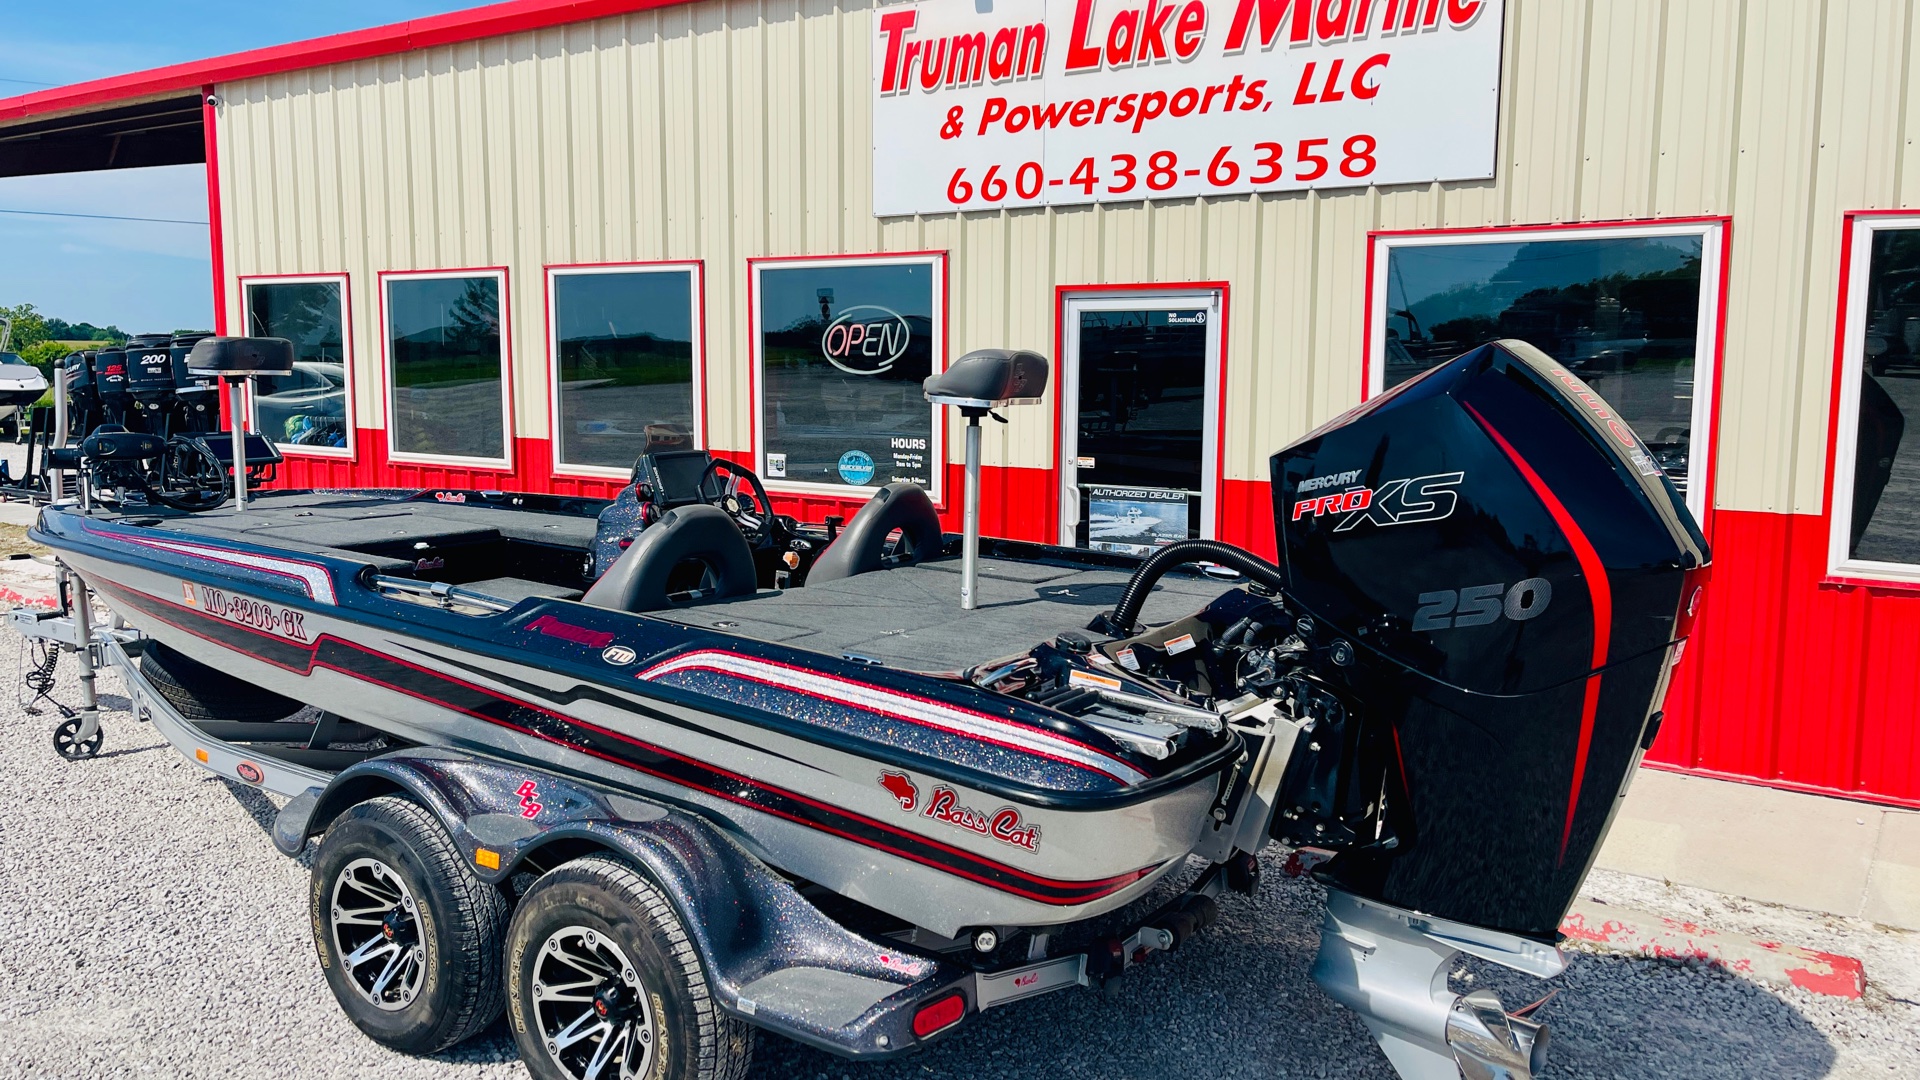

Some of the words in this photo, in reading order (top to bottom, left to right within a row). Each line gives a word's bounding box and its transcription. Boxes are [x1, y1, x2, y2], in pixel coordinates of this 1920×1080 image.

[880, 10, 1048, 94] Truman
[1064, 0, 1207, 72] Lake
[940, 105, 964, 140] &
[977, 80, 1273, 137] Powersports,
[1292, 53, 1392, 106] LLC
[947, 134, 1377, 204] 660-438-6358
[106, 364, 123, 372] 125
[140, 354, 166, 365] 200
[827, 323, 901, 356] OPEN
[891, 437, 926, 450] HOURS
[1092, 488, 1147, 498] AUTHORIZED
[1149, 491, 1185, 500] DEALER
[1291, 489, 1374, 521] PRO
[1333, 471, 1465, 533] XS
[1297, 469, 1363, 493] MERCURY
[1411, 577, 1553, 632] 250
[922, 786, 990, 836] Bass
[989, 807, 1039, 853] Cat
[310, 883, 330, 969] GENERAL
[509, 939, 528, 1034] GENERAL
